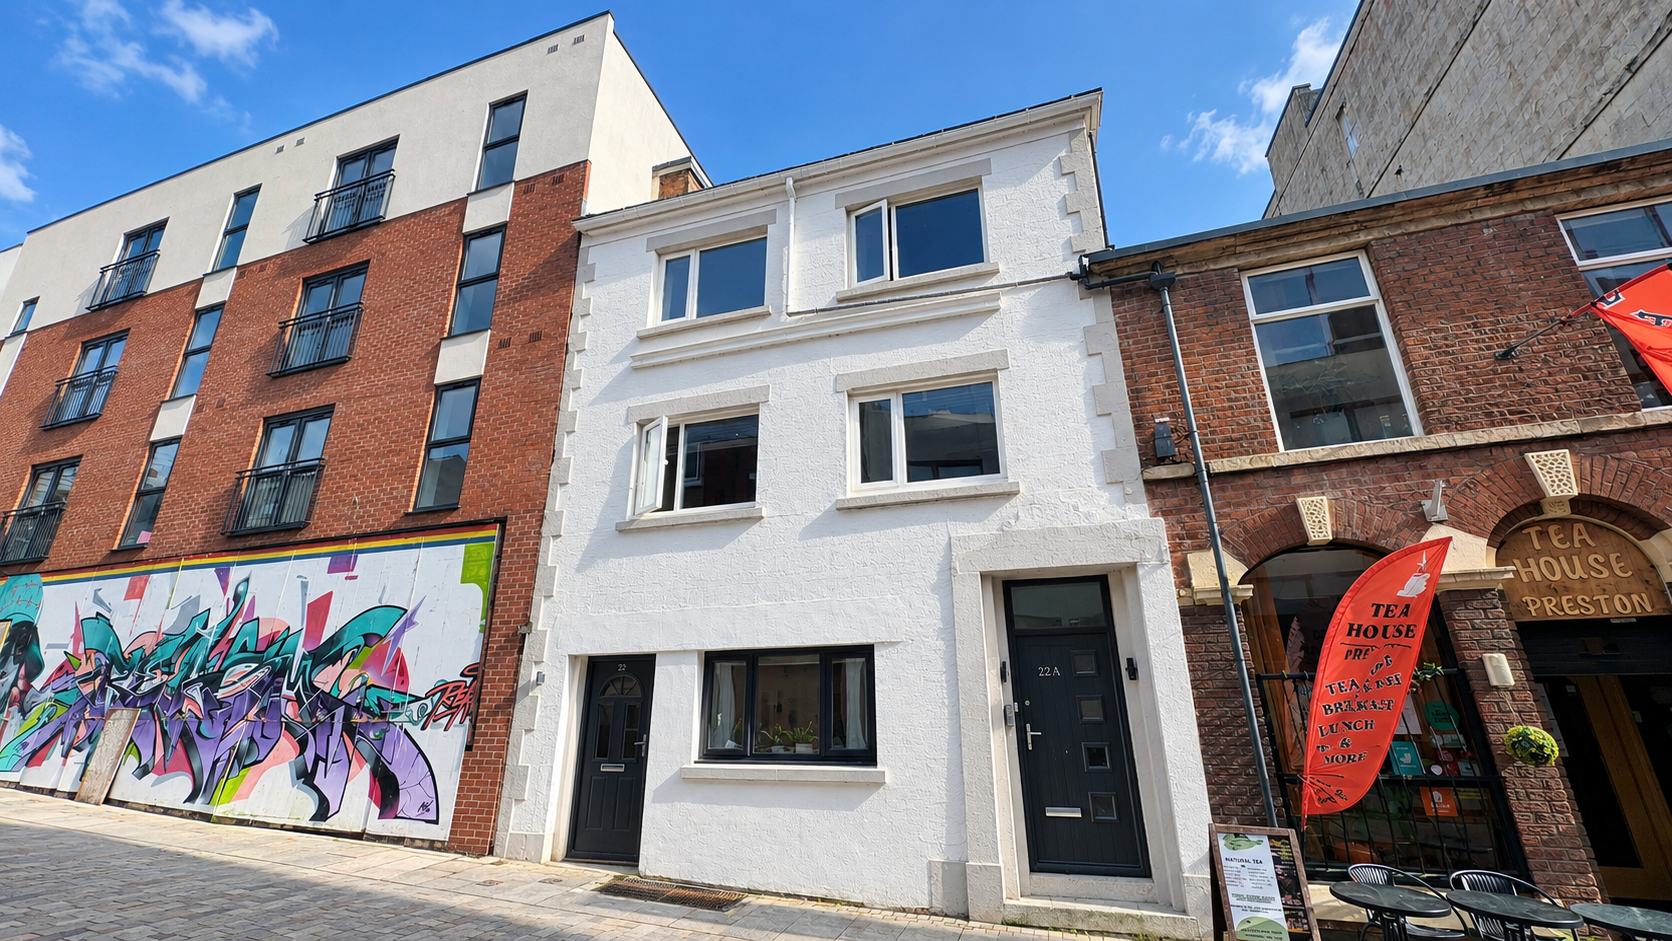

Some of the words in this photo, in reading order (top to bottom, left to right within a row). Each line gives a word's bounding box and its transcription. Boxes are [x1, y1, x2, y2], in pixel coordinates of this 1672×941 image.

[1521, 522, 1597, 550] TEA
[1512, 552, 1633, 583] HOUSE
[1371, 602, 1411, 618] TEA
[1521, 592, 1653, 617] PRESTON
[1345, 622, 1417, 639] HOUSE
[617, 663, 627, 671] 22
[1038, 666, 1061, 676] 22A
[1325, 678, 1360, 695] TEA
[1318, 719, 1375, 737] LUNCH
